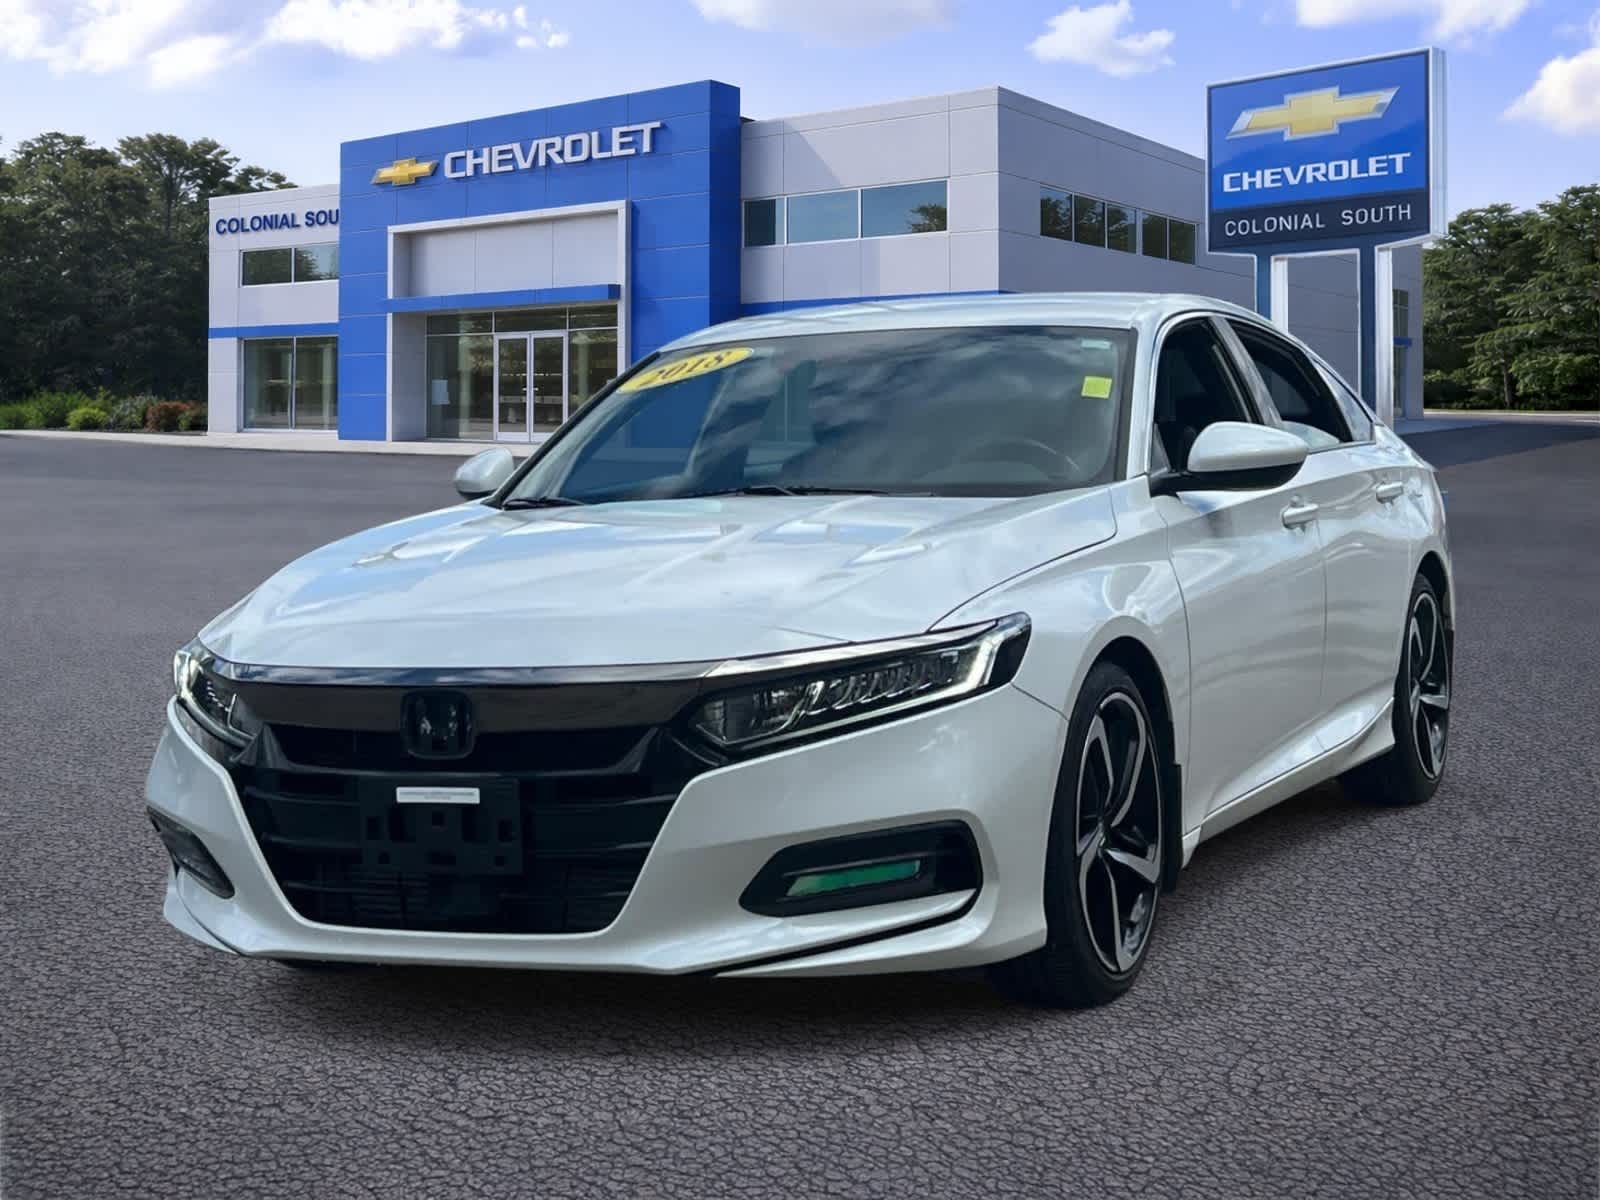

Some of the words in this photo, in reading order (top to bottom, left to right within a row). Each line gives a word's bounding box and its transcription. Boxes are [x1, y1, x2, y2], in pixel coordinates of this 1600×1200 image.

[444, 121, 662, 179] CHEVROLET
[1222, 152, 1411, 193] CHEVROLET
[215, 212, 300, 235] COLONIAL
[1224, 212, 1326, 237] COLONIAL
[1341, 203, 1412, 226] SOUTH
